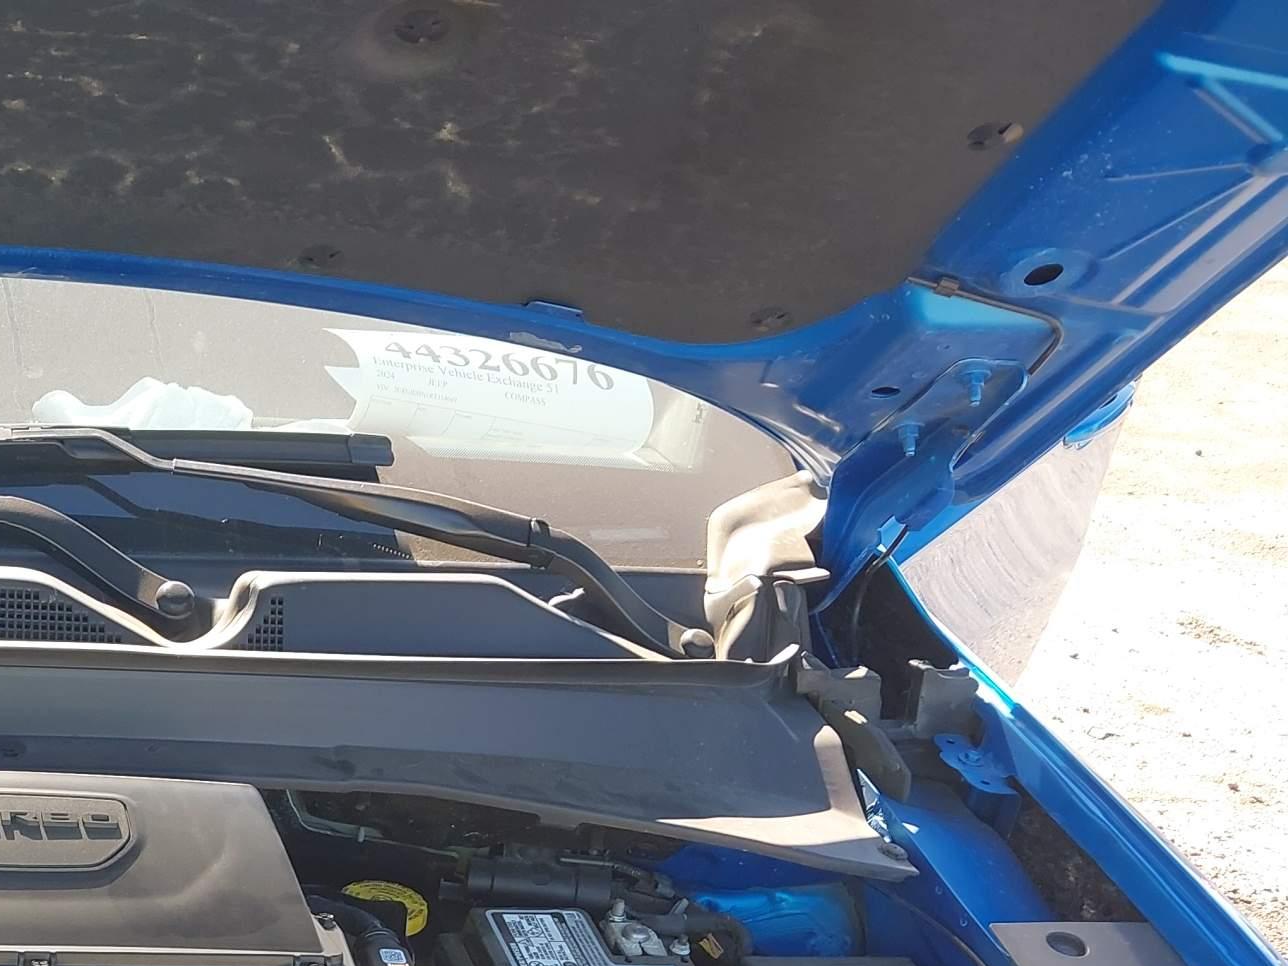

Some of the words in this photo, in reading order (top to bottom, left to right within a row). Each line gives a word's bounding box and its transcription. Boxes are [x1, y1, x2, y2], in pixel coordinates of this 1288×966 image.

[373, 356, 435, 374] Enterprise
[438, 366, 483, 381] Vehicle
[488, 373, 543, 393] Exchange
[546, 383, 559, 394] 51
[385, 342, 614, 390] 44326676
[504, 392, 547, 407] COMPASS
